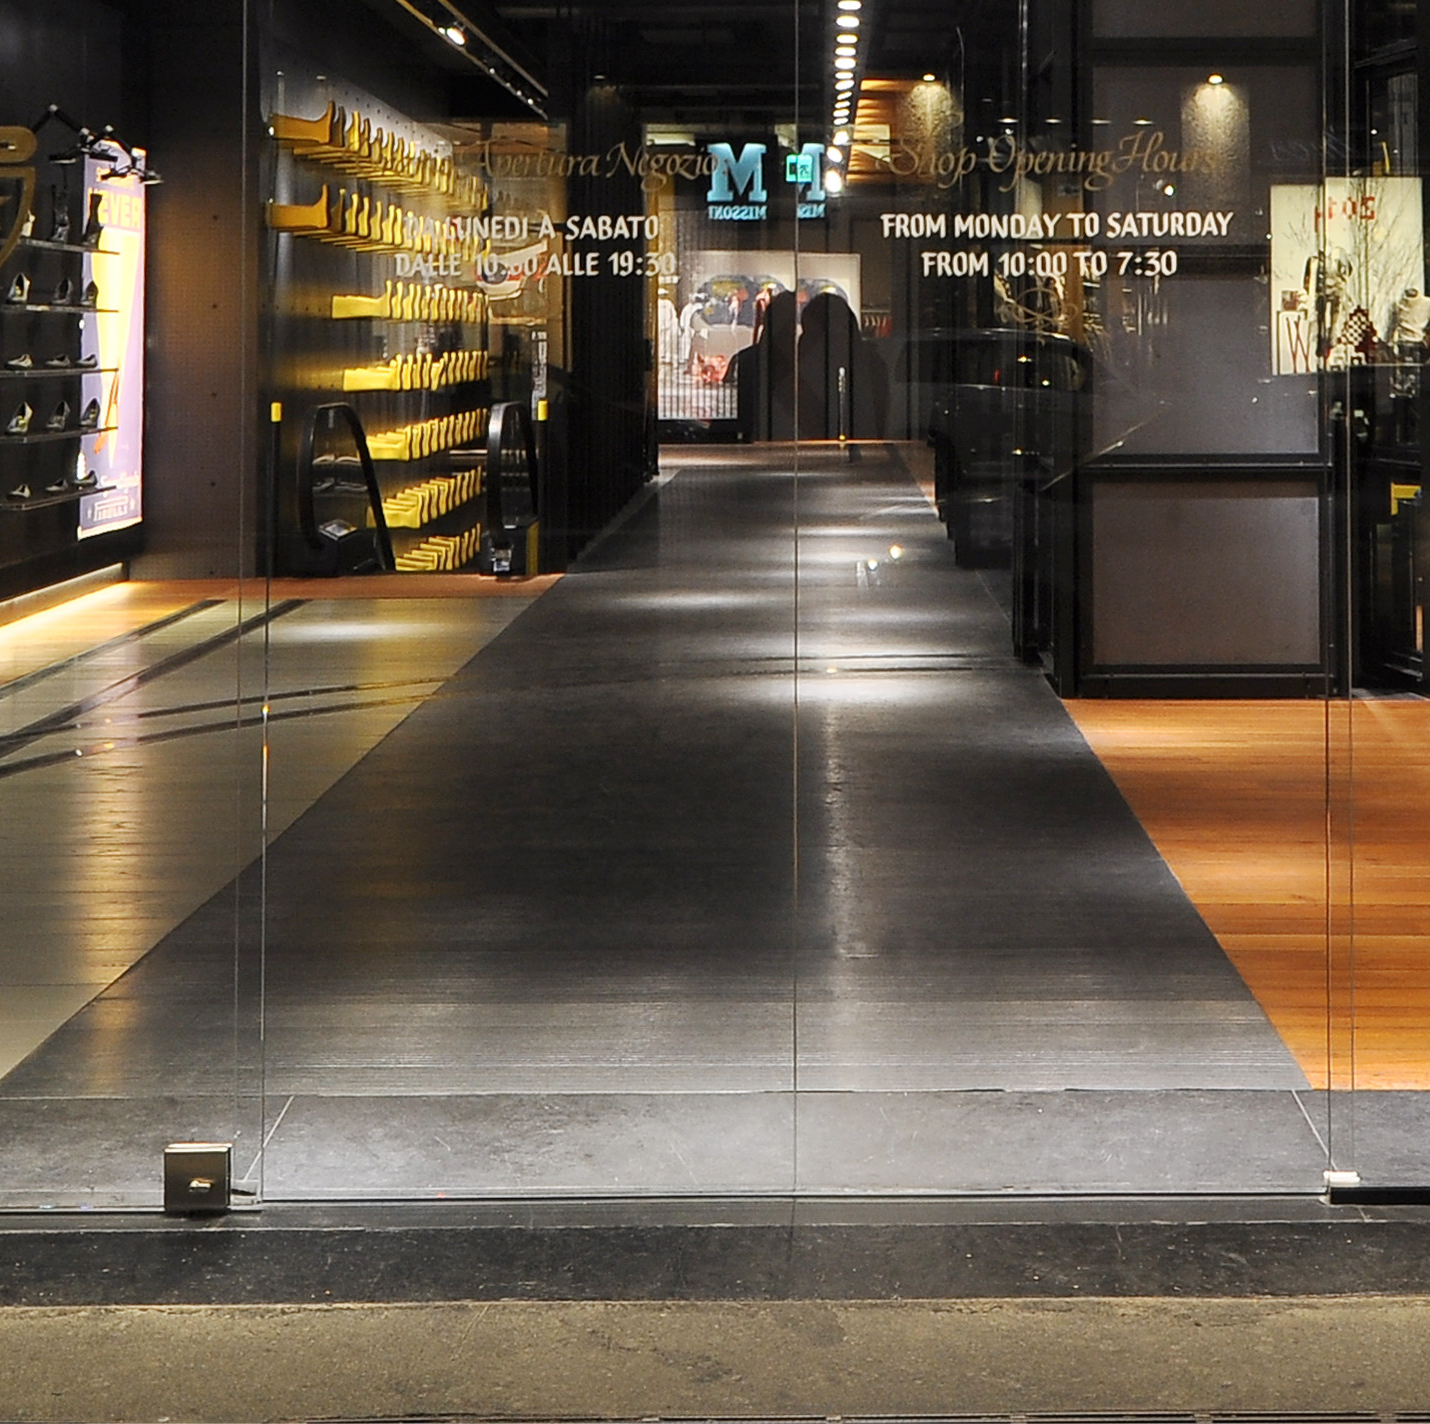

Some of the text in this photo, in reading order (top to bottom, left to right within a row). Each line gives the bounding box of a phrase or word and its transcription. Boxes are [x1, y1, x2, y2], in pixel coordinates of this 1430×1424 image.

[875, 136, 978, 190] Shop
[985, 135, 1114, 192] Opening
[538, 216, 556, 240] A
[564, 214, 660, 240] SABATO
[880, 211, 1235, 239] FROM MONDAY TO SATURDAY
[394, 252, 462, 277] DALLE
[544, 252, 599, 277] ALLE
[607, 251, 676, 277] 19:30
[922, 250, 1178, 277] FROM 10:00 TO 7:30
